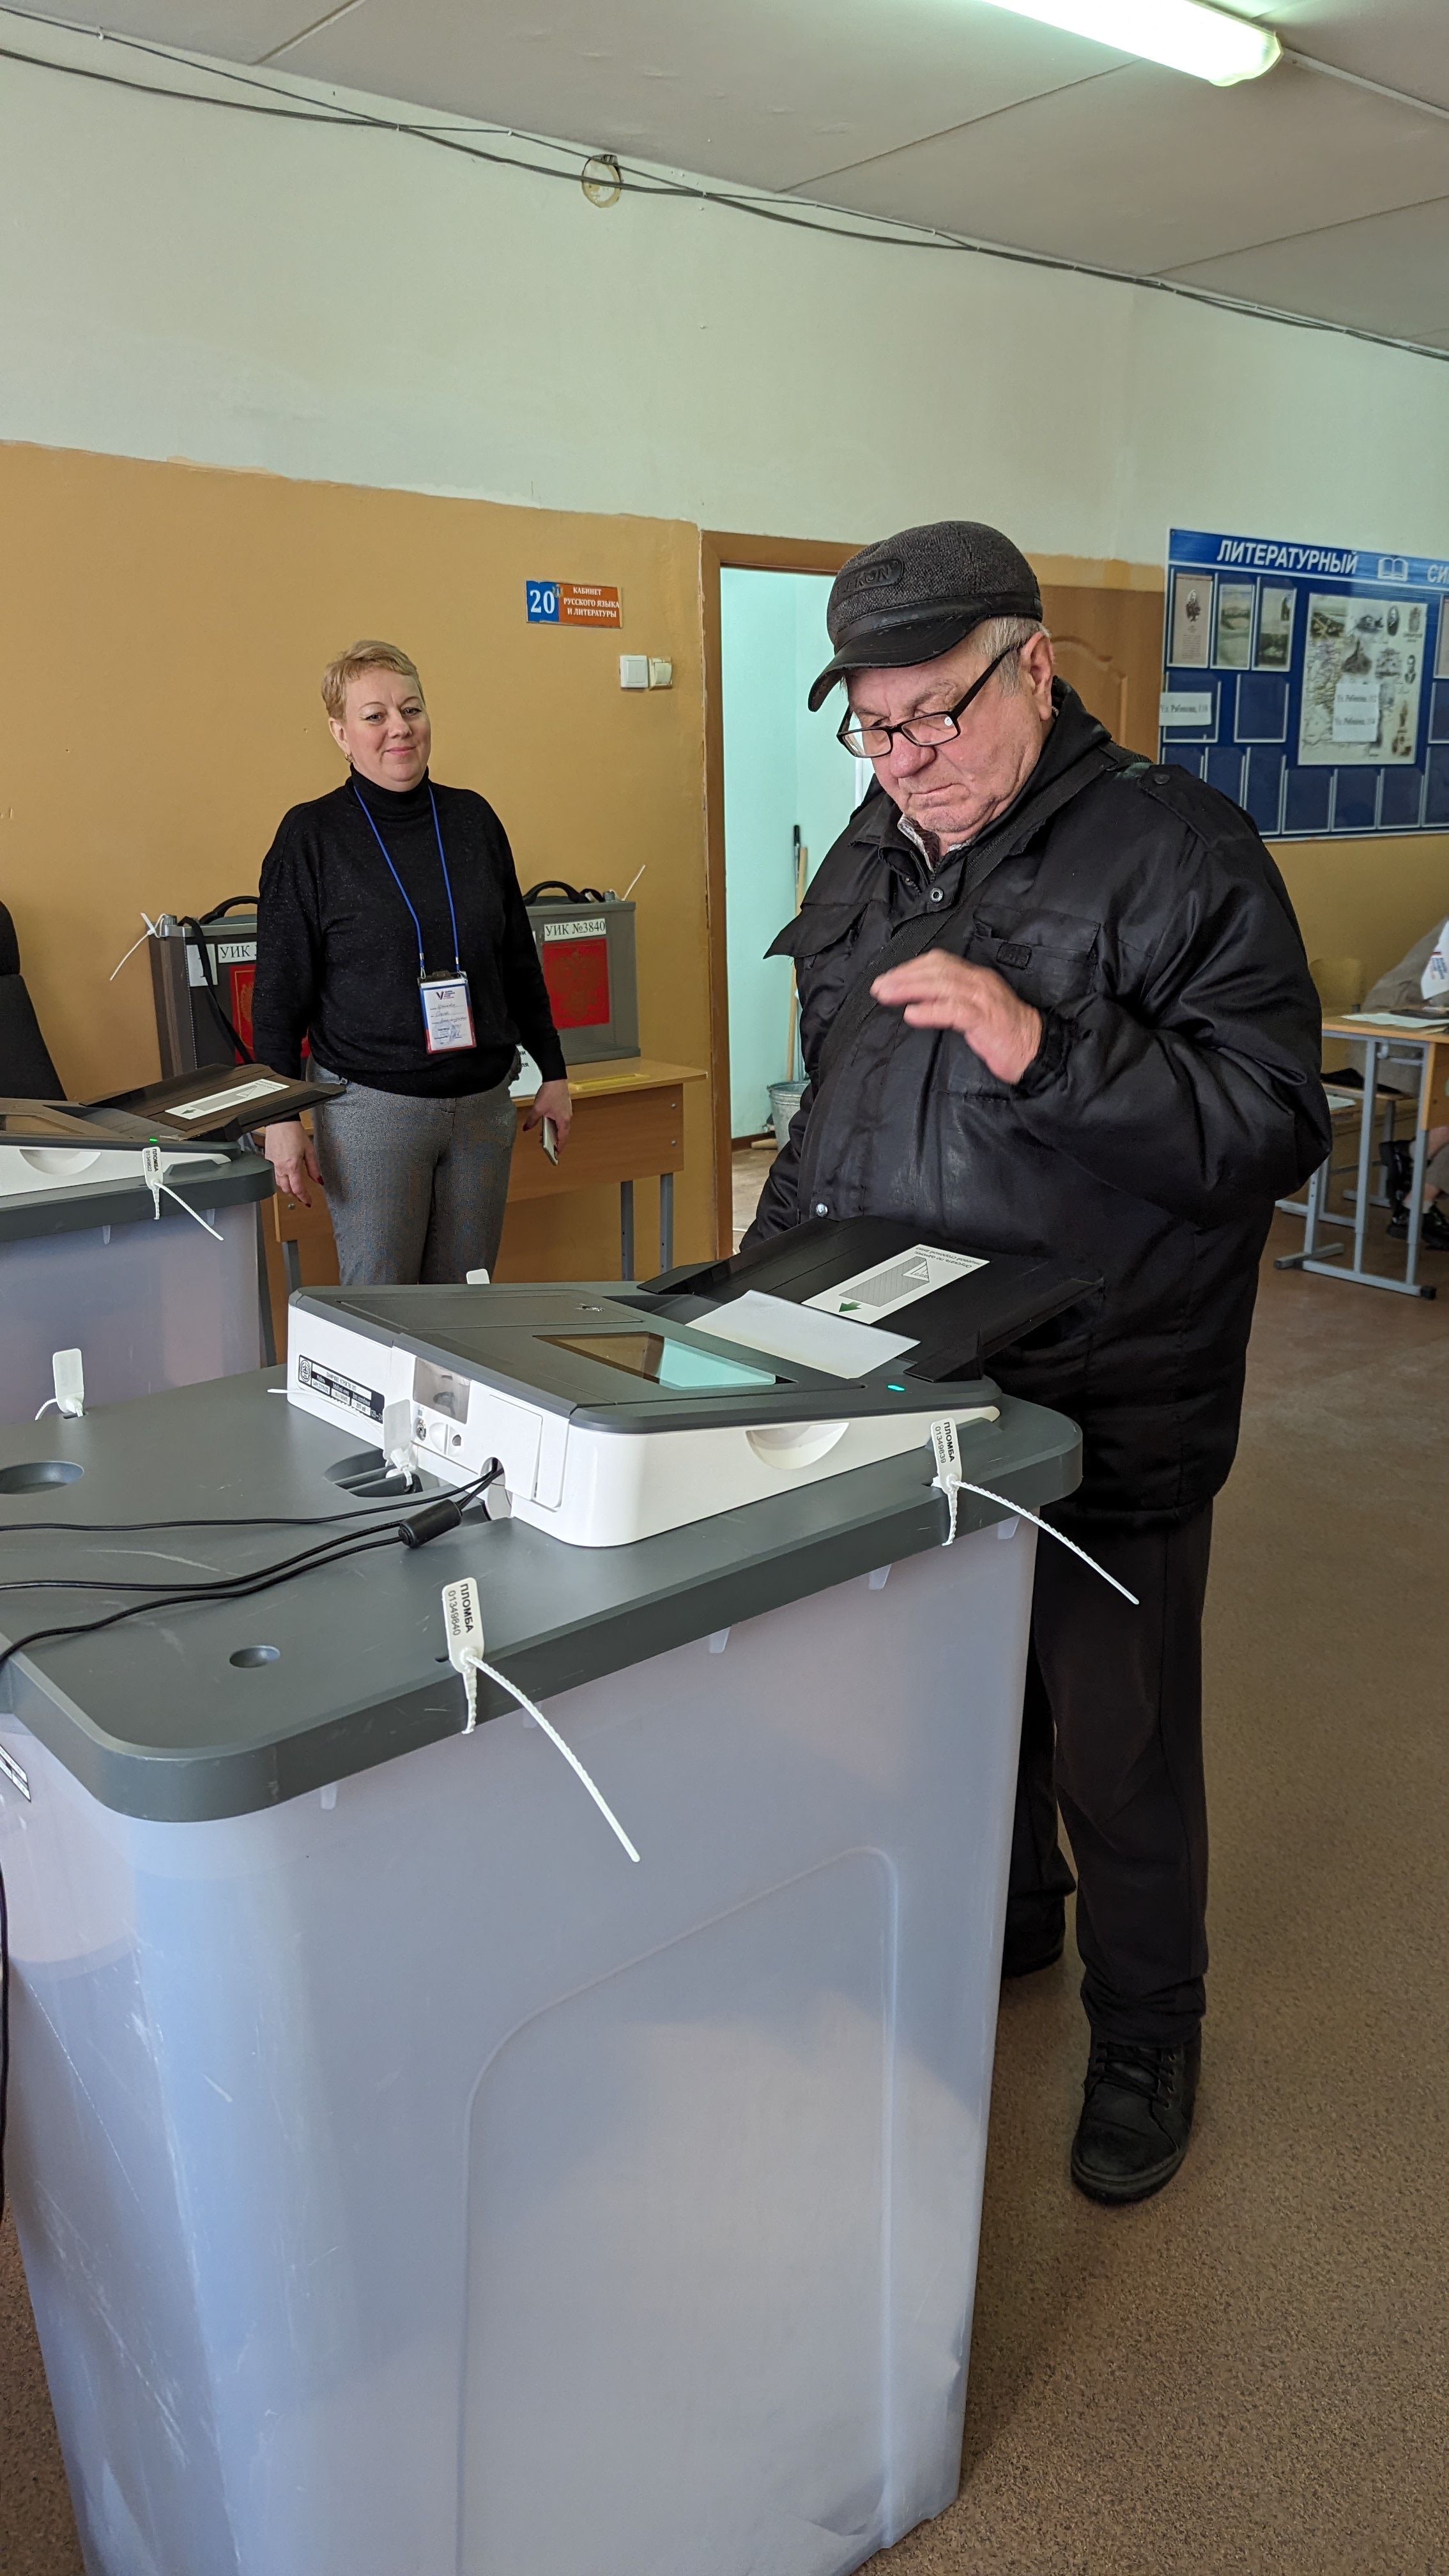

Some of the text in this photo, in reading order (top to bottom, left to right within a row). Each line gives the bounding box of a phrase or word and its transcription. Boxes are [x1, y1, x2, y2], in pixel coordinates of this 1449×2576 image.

[1216, 540, 1358, 574] ЛИТЕРАТУРНЫЙ
[573, 586, 602, 595] КАБИНЕТ
[530, 590, 555, 614] 20
[564, 597, 620, 608] РУССКОГО ЯЗЫКА
[573, 608, 617, 618] ЛИТЕРАТУРЫ
[545, 921, 606, 937] УИК №3840
[220, 945, 250, 958] УИК
[935, 1426, 946, 1464] 01349839
[944, 1422, 954, 1462] ПЛОМБА
[460, 1583, 473, 1634] ПЛОМБА
